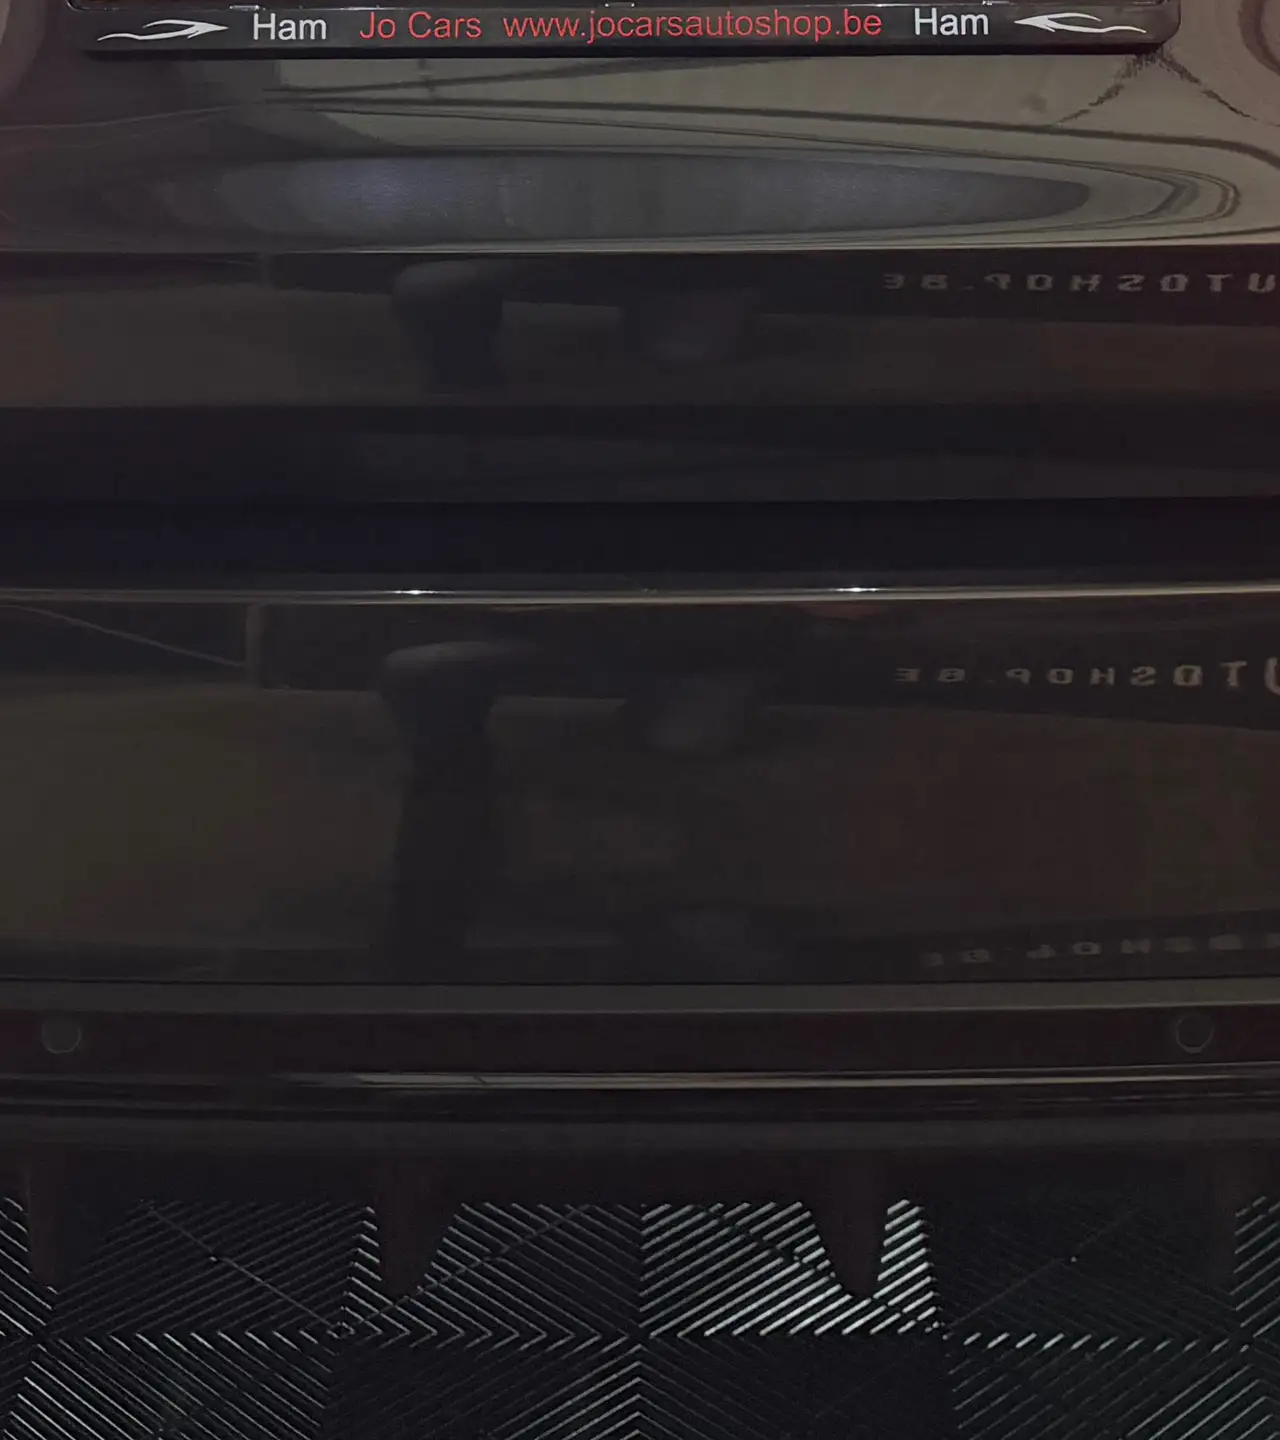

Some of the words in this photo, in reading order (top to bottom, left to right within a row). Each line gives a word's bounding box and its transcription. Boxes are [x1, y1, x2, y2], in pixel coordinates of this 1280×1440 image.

[253, 12, 327, 41] Ham
[359, 12, 397, 40] Jo
[407, 11, 483, 40] Cars
[502, 9, 883, 44] www.jocarsautoshop.be
[913, 8, 990, 37] Ham
